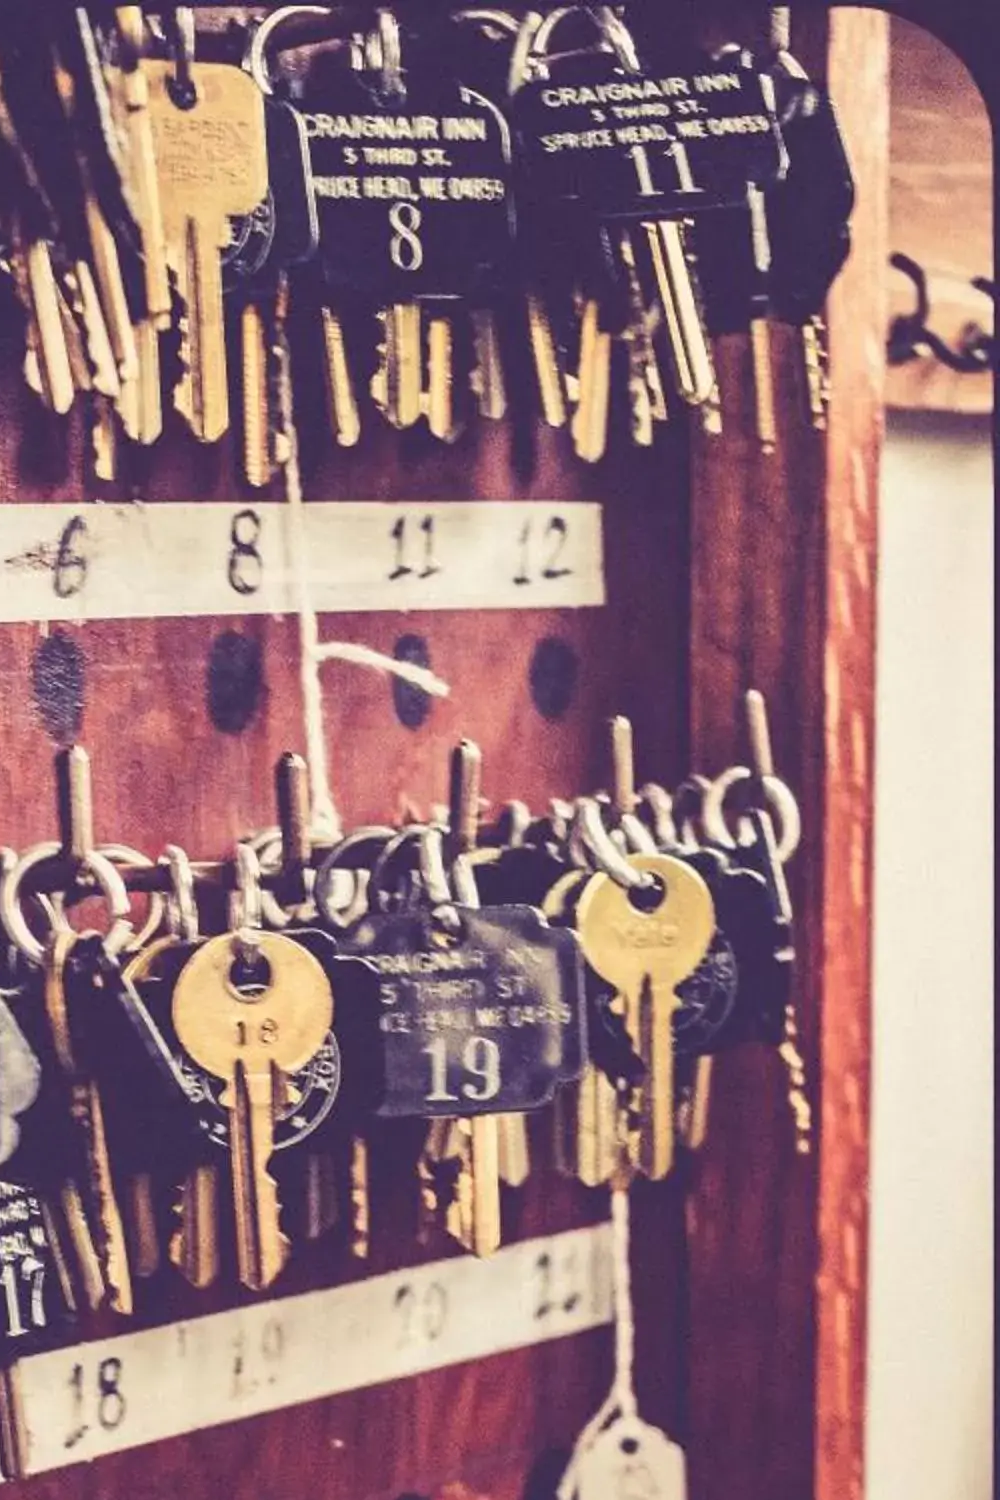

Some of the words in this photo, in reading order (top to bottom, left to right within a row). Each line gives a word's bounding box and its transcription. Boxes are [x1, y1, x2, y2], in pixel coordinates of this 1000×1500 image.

[541, 77, 691, 108] CRAIGNAIR
[693, 73, 741, 94] INN
[611, 102, 671, 119] THIRD
[441, 117, 486, 141] INN
[539, 129, 614, 152] SPRUCE
[362, 147, 418, 165] THIRD
[624, 141, 706, 197] 11
[389, 202, 423, 271] 8
[228, 509, 262, 594] 8
[388, 516, 440, 581] 11
[514, 516, 572, 585] 12
[236, 1017, 278, 1045] 18
[420, 1037, 501, 1101] 19
[65, 1356, 126, 1448] 18
